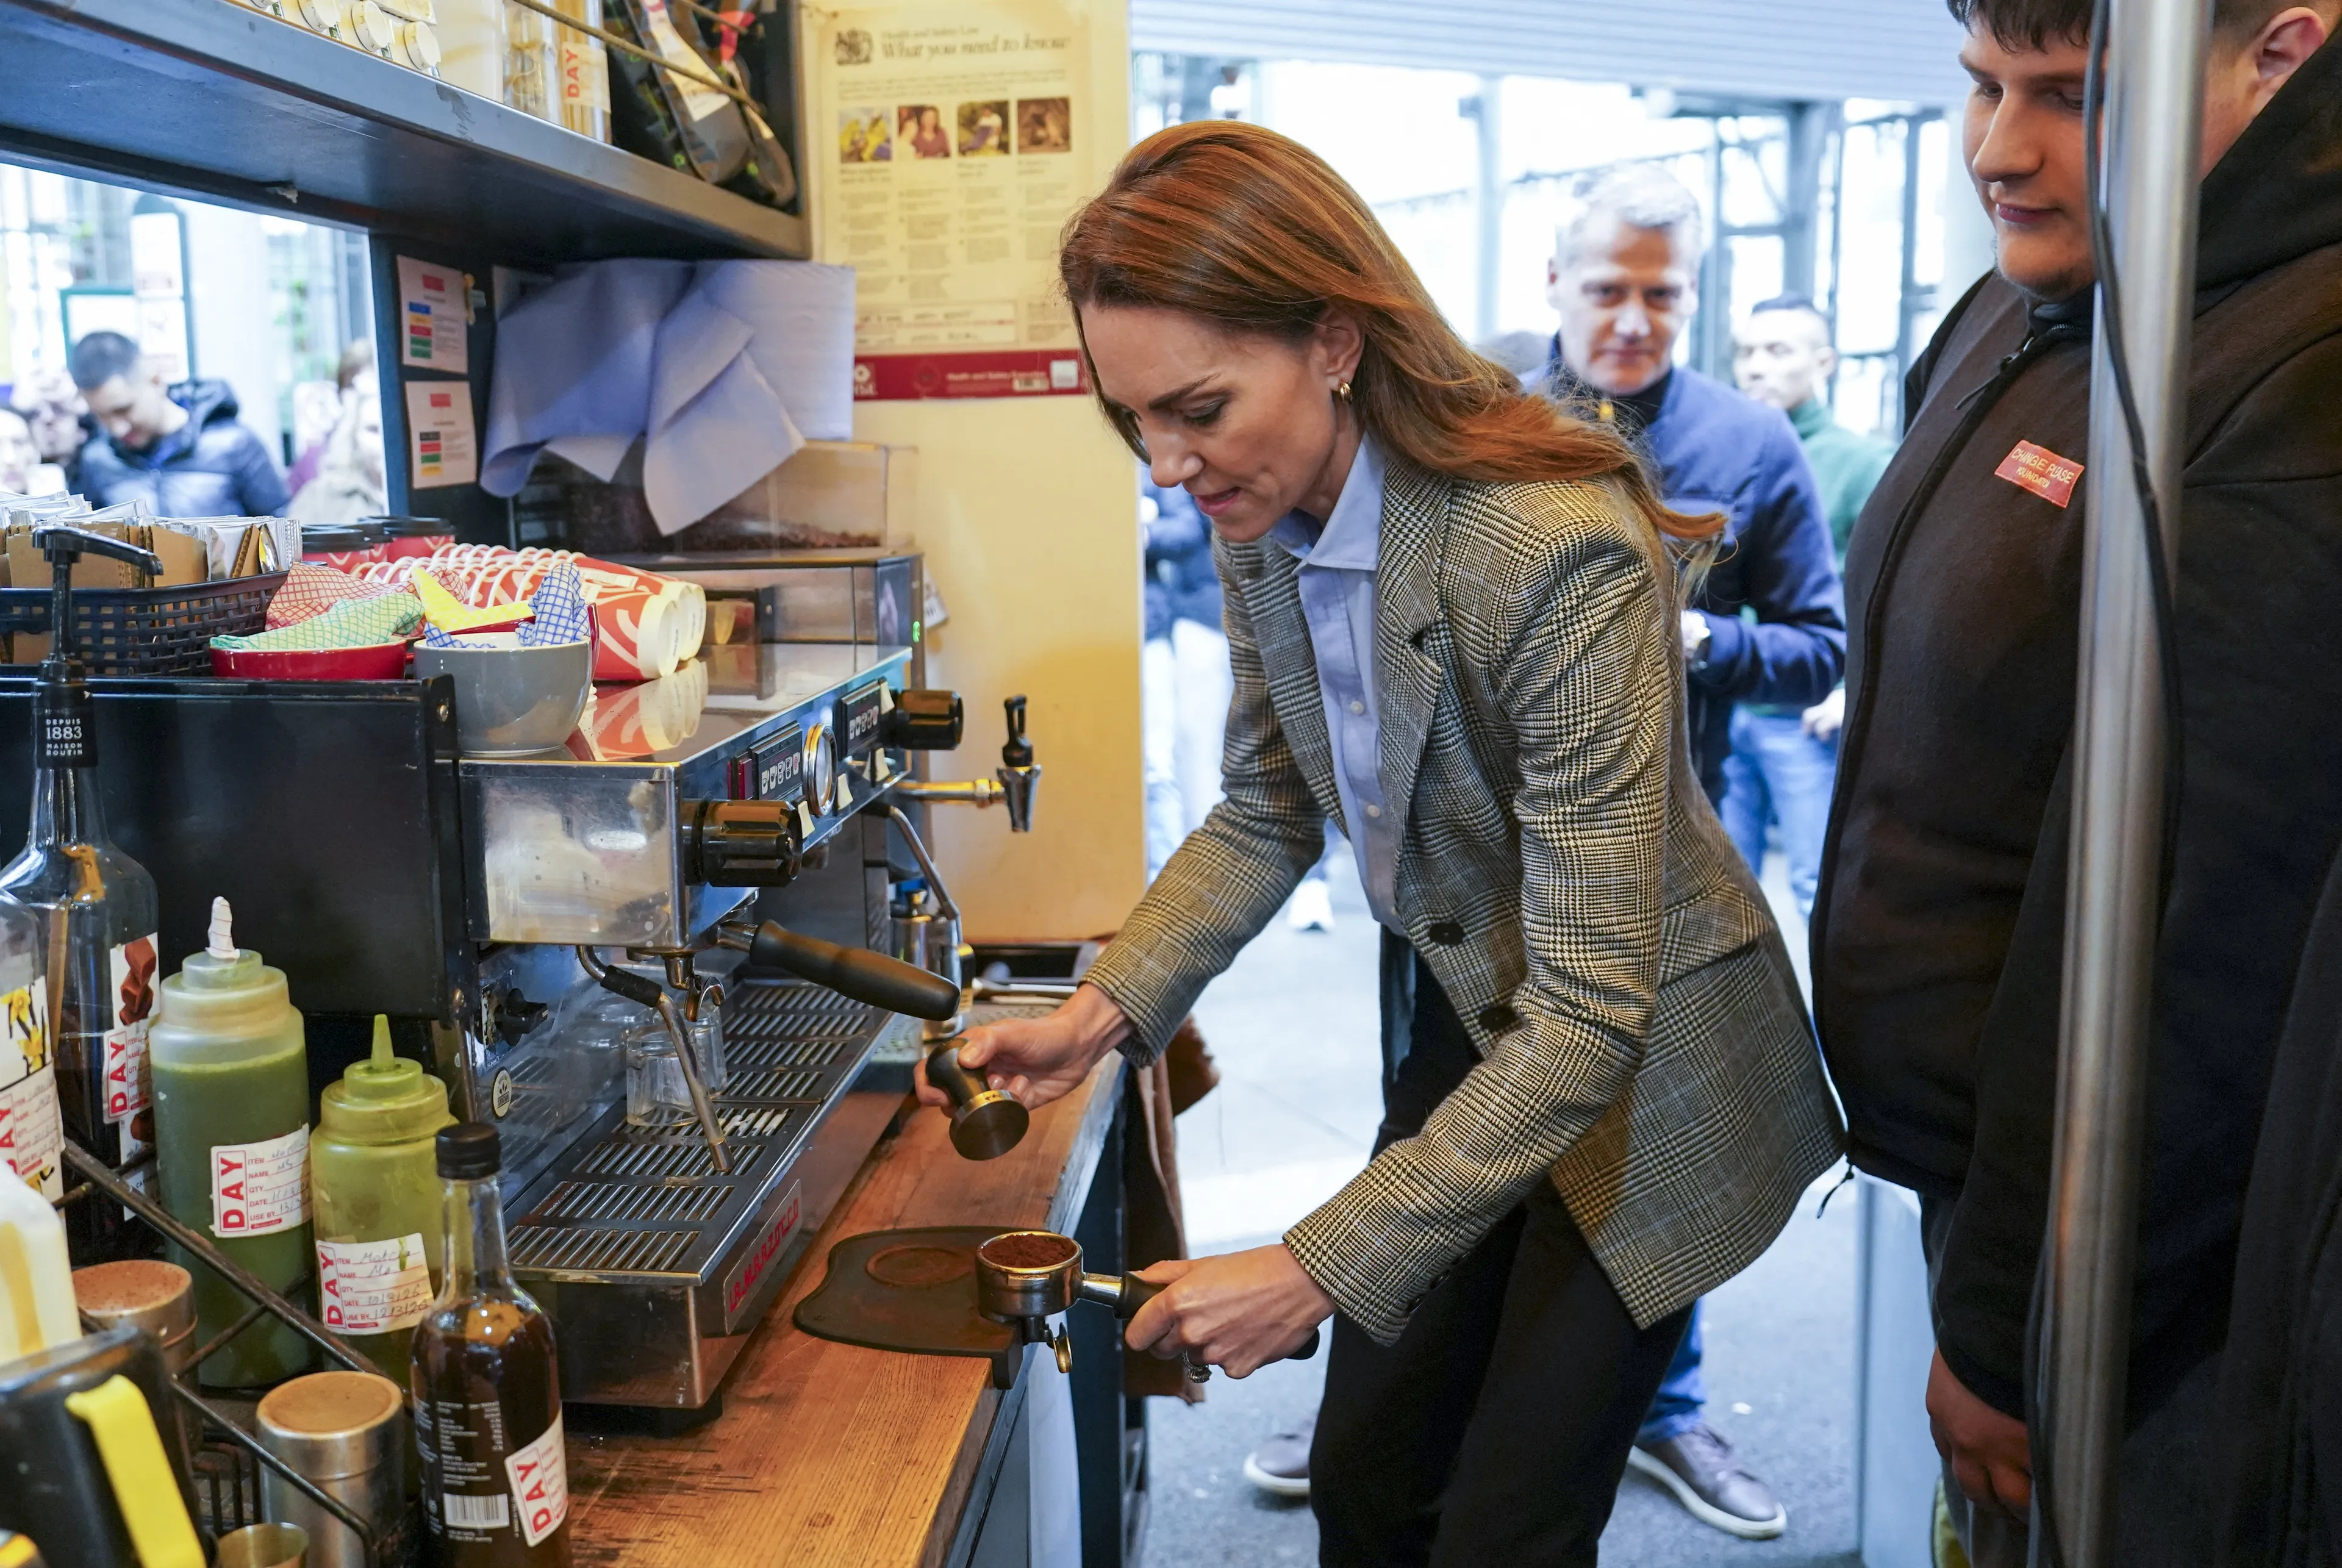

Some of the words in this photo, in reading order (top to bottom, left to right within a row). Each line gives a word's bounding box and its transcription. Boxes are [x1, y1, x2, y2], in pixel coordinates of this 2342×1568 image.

[566, 48, 579, 98] DAY
[2011, 448, 2048, 471] CHANGE
[46, 726, 82, 740] 1883
[110, 1040, 127, 1114] DAY
[220, 1157, 245, 1229] DAY
[249, 1198, 268, 1207] DATE
[320, 1251, 343, 1325] DAY
[517, 1460, 552, 1533] DAY
